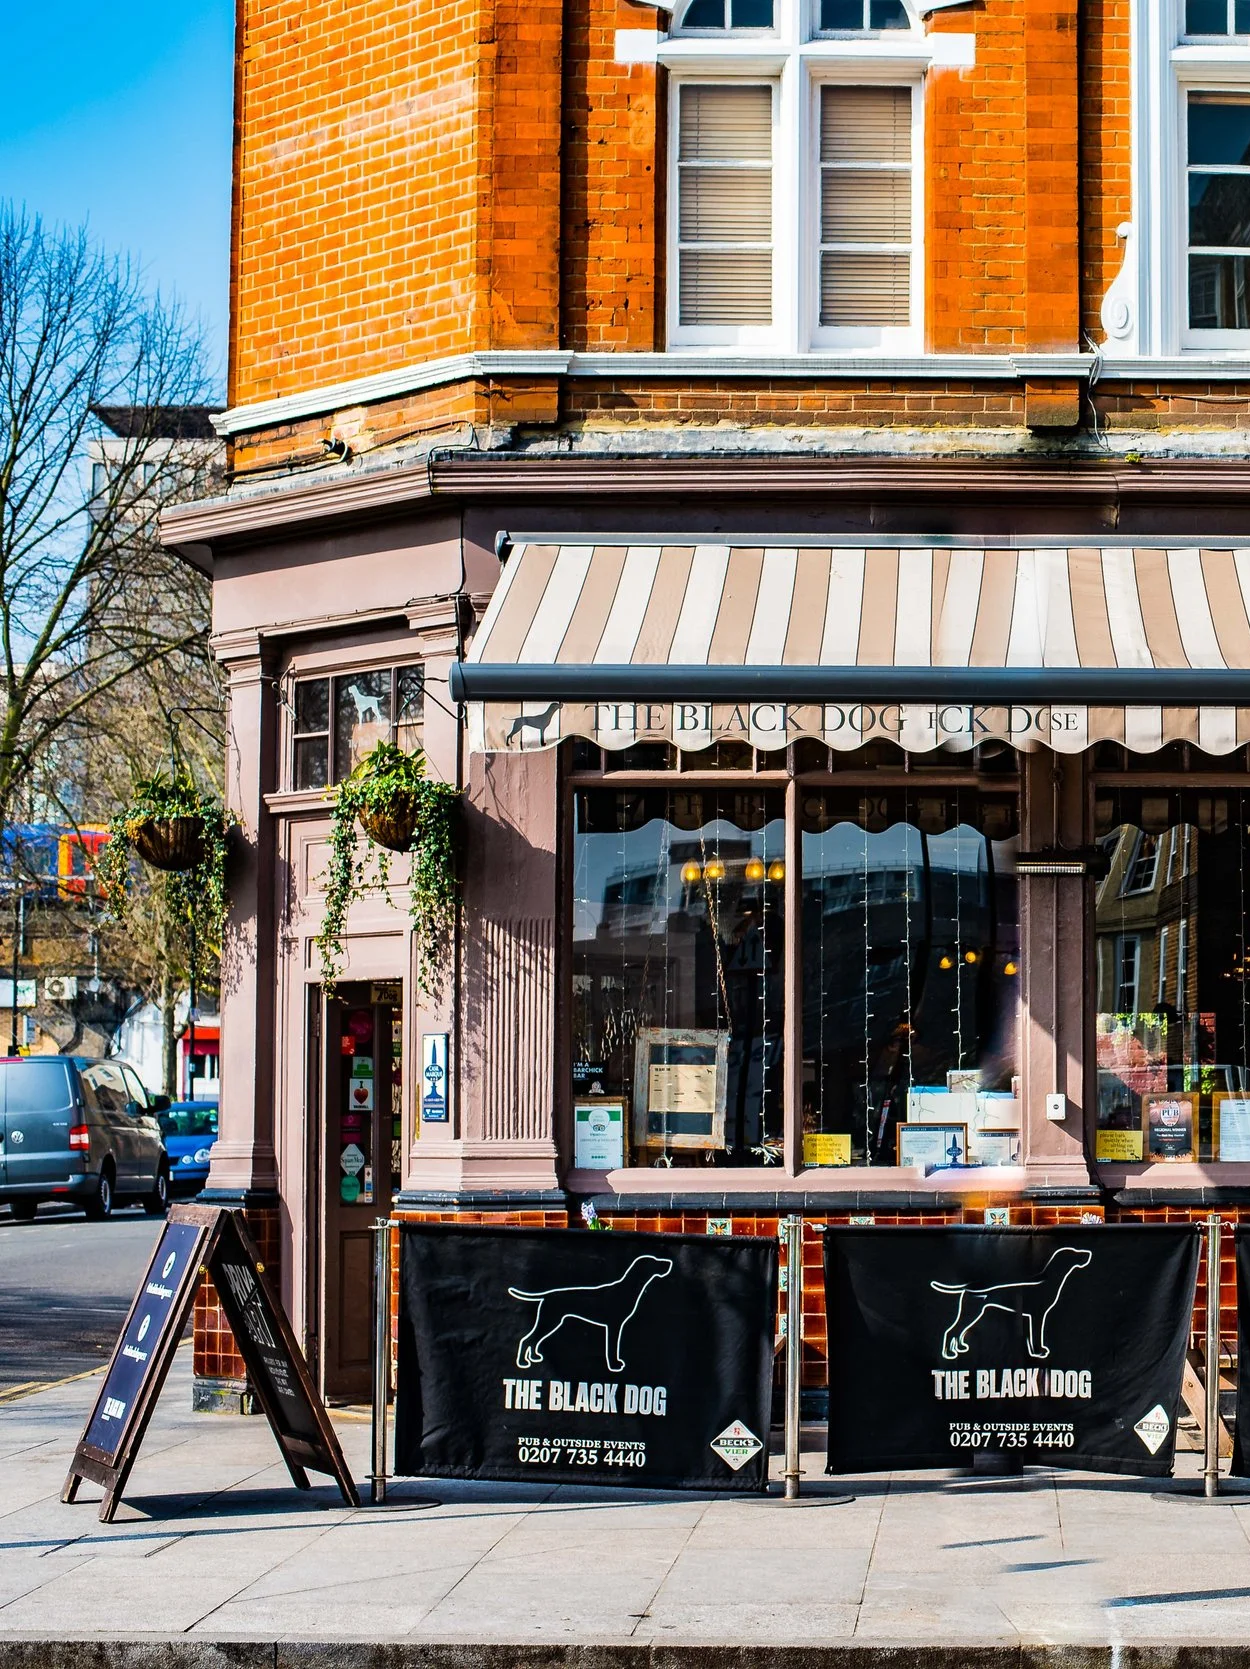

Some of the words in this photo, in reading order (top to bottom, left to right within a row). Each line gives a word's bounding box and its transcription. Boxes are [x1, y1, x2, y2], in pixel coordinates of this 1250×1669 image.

[584, 704, 667, 731] THE
[677, 704, 806, 732] BLACK
[818, 704, 908, 732] DOG
[359, 1081, 364, 1089] I
[931, 1369, 970, 1400] THE
[976, 1367, 1040, 1399] BLACK
[1050, 1369, 1092, 1399] DOG
[503, 1378, 542, 1410] THE
[549, 1380, 618, 1414] BLACK
[624, 1384, 667, 1416] DOG
[949, 1423, 971, 1432] PUB
[973, 1423, 981, 1432] &
[983, 1423, 1031, 1432] OUTSIDE
[1032, 1423, 1074, 1432] EVENTS
[518, 1437, 541, 1446] PUB
[542, 1438, 551, 1447] &
[552, 1438, 601, 1449] OUTSIDE
[603, 1440, 646, 1450] EVENTS
[950, 1431, 990, 1448] 0207
[996, 1431, 1028, 1448] 735
[1033, 1431, 1075, 1448] 4440
[518, 1447, 560, 1464] 0207
[567, 1448, 598, 1465] 735
[603, 1450, 646, 1467] 4440
